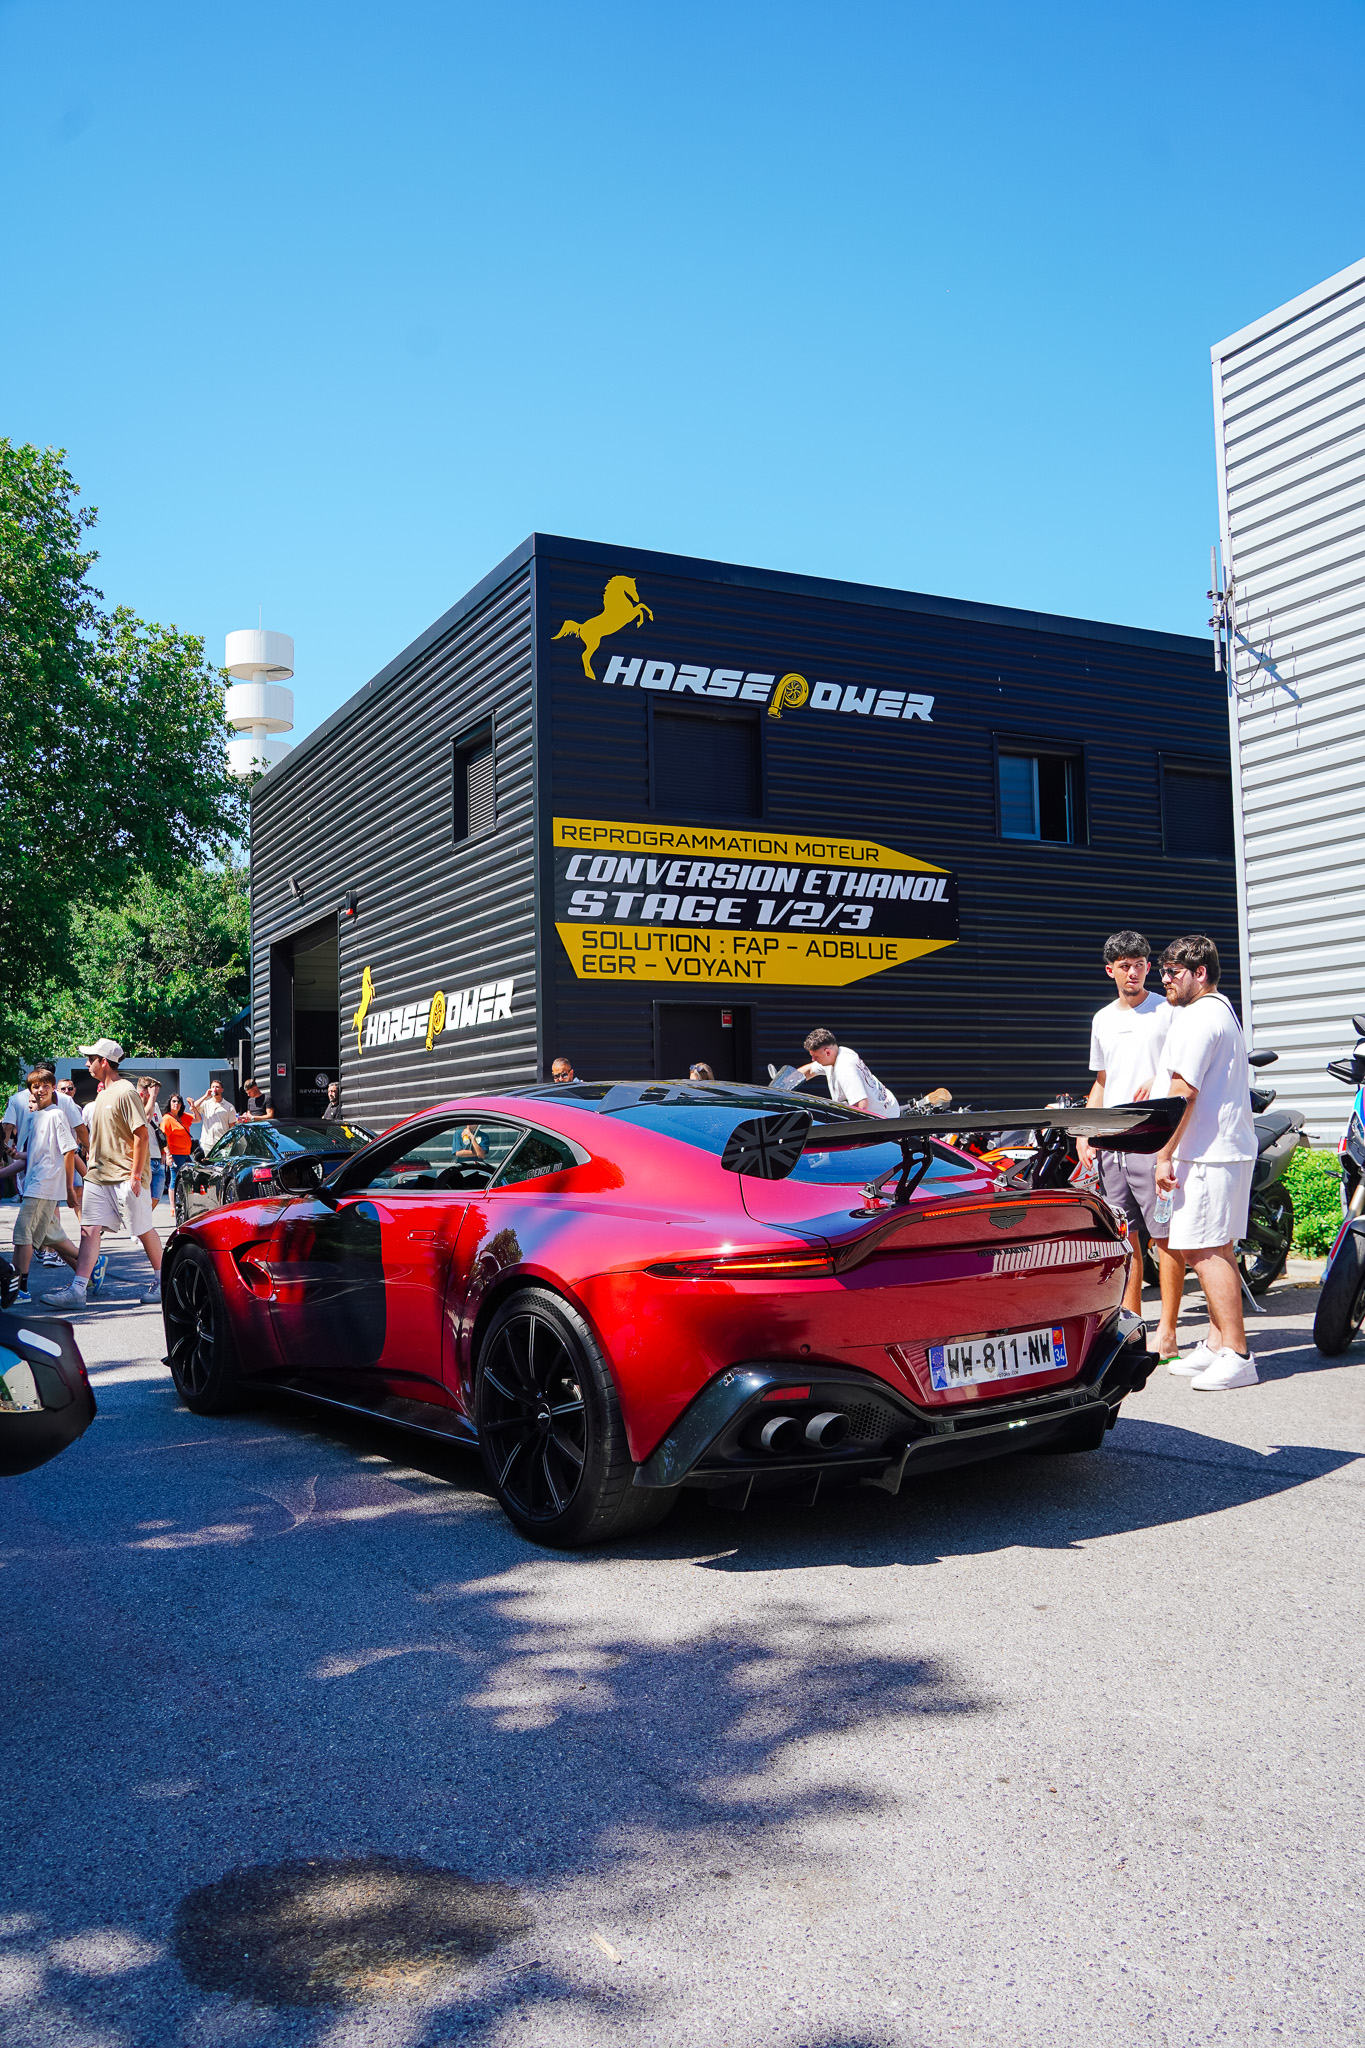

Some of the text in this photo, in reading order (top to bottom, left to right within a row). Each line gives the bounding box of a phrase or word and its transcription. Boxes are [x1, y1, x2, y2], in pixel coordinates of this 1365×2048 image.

[602, 655, 935, 722] HORSEPOWER
[561, 825, 880, 862] REPROGRAMMATION MOTEUR
[565, 854, 950, 903] CONVERSION ETHANOL
[567, 889, 874, 930] STAGE 1/2/3
[581, 930, 711, 954] SOLUTION
[733, 936, 779, 956] FAP
[805, 939, 898, 961] ADBLUE
[582, 954, 636, 974] EGR
[665, 957, 766, 978] VOYANT
[364, 979, 514, 1051] HORSEPOWER
[947, 1332, 1051, 1380] WW-811-NW
[1054, 1347, 1066, 1362] 34
